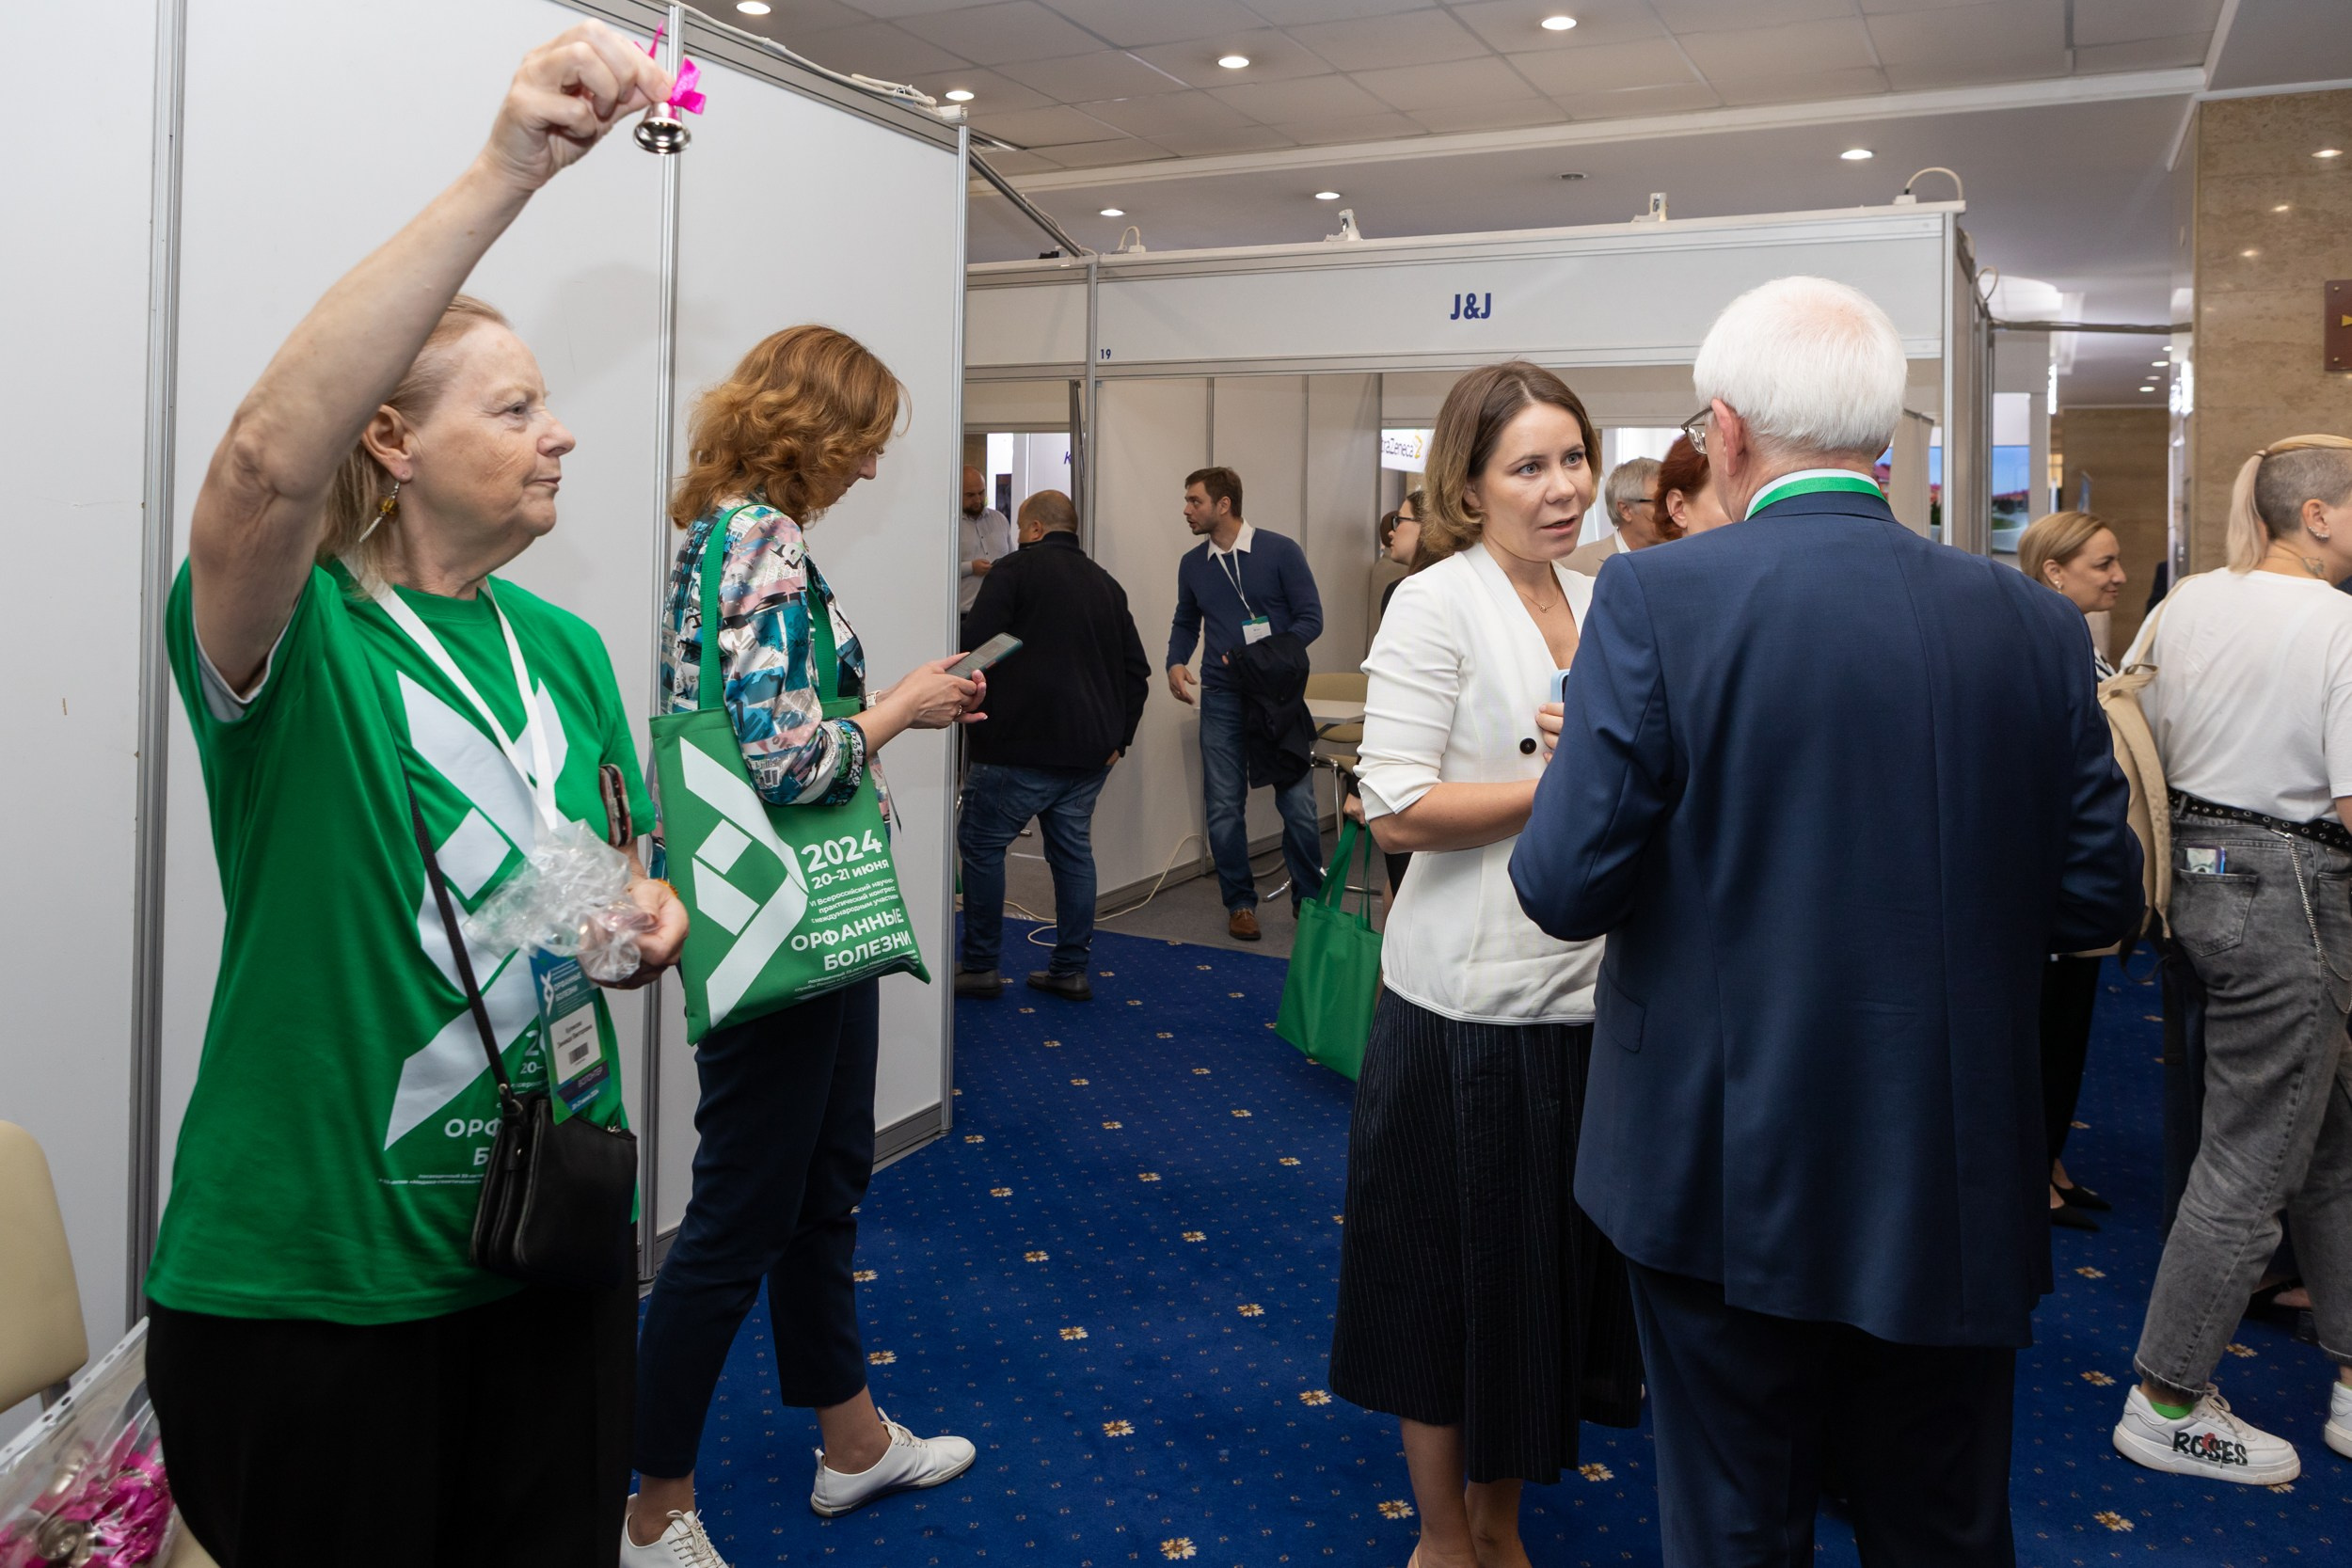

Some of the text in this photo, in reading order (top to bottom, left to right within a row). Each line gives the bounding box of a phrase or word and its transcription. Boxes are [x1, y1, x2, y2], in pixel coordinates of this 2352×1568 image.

[1450, 293, 1491, 320] J&J
[1101, 349, 1111, 359] 19
[1381, 437, 1413, 458] raZeneca
[801, 829, 882, 873] 2024
[817, 883, 871, 905] Всероссийский
[818, 893, 868, 913] практический
[790, 908, 904, 952] ОРФАННЫЕ
[823, 929, 912, 971] БОЛЕЗНИ
[2172, 1431, 2248, 1465] ROSES
